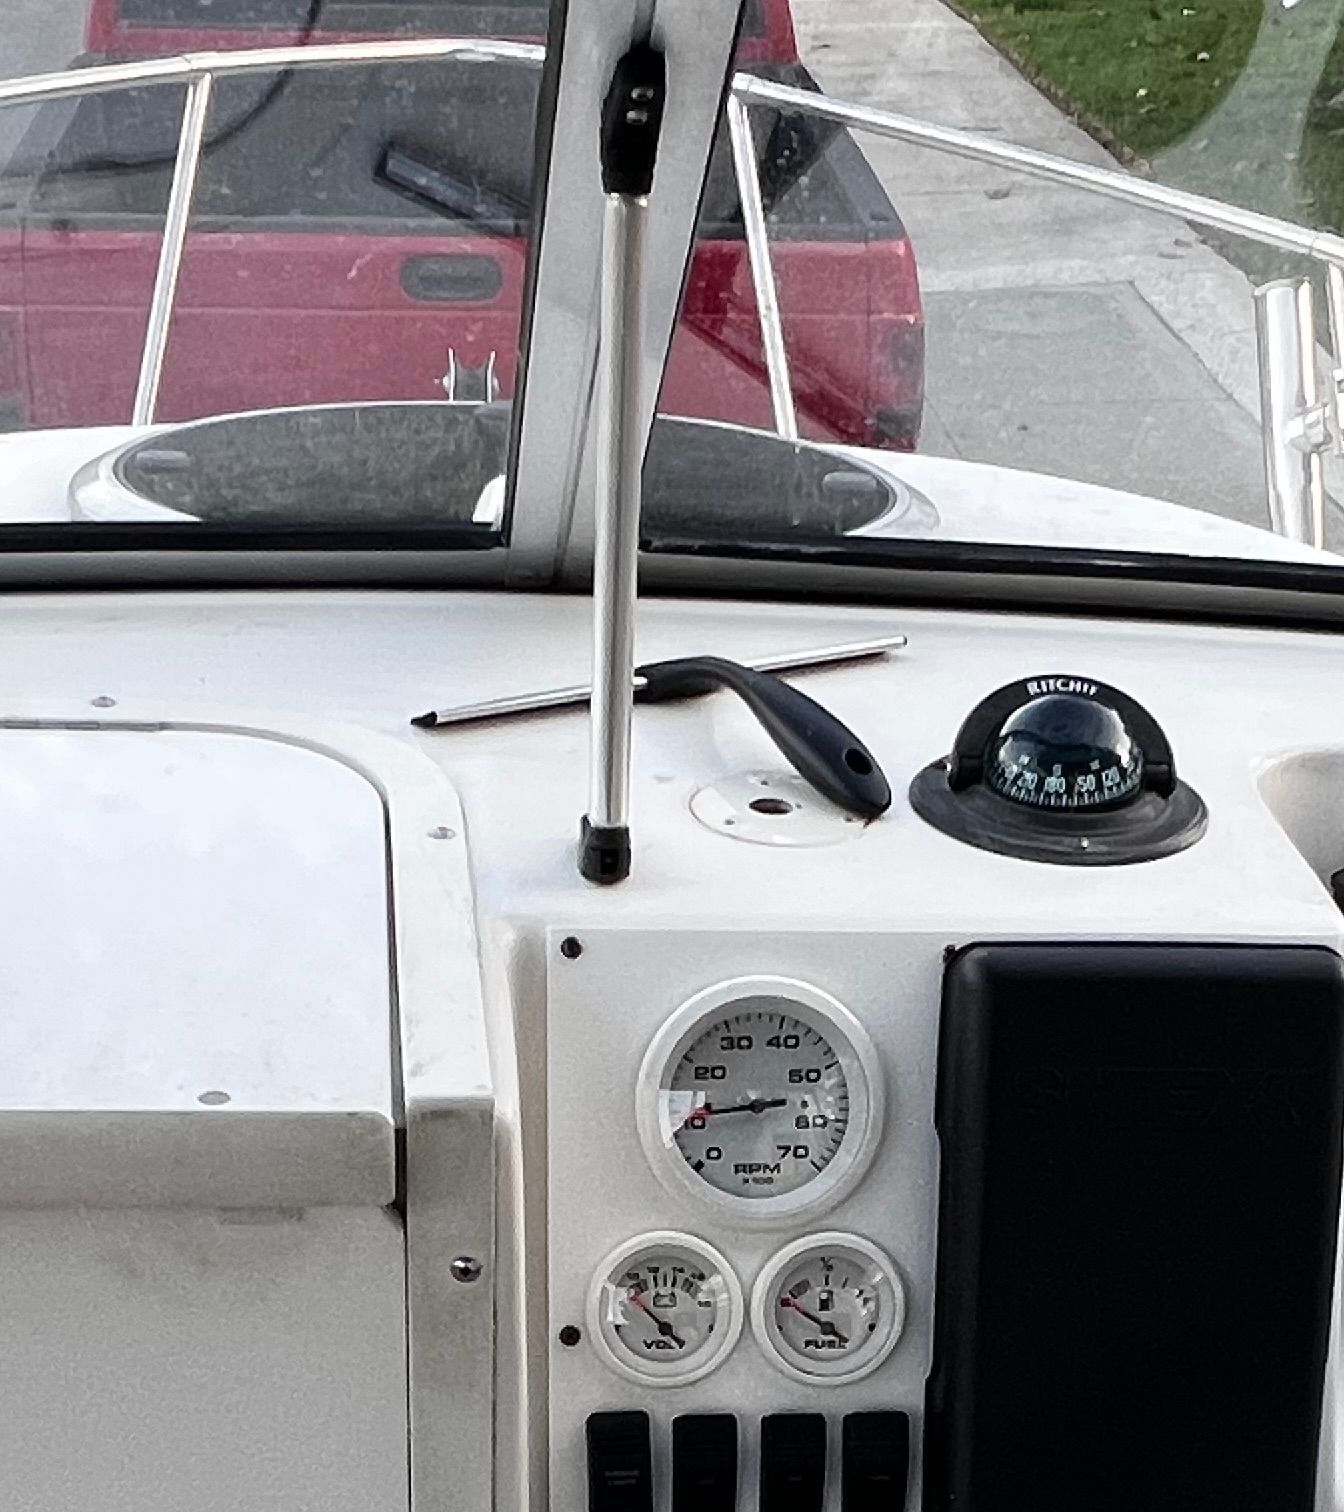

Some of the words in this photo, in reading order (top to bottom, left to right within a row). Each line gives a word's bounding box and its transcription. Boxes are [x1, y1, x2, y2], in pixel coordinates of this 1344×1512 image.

[1026, 678, 1098, 696] RITCHIE
[721, 1034, 753, 1050] 30
[766, 1034, 800, 1050] 40
[694, 1065, 726, 1080] 20
[795, 1114, 829, 1129] 60
[706, 1146, 722, 1160] 0
[777, 1145, 810, 1160] 70
[733, 1162, 781, 1175] RPM
